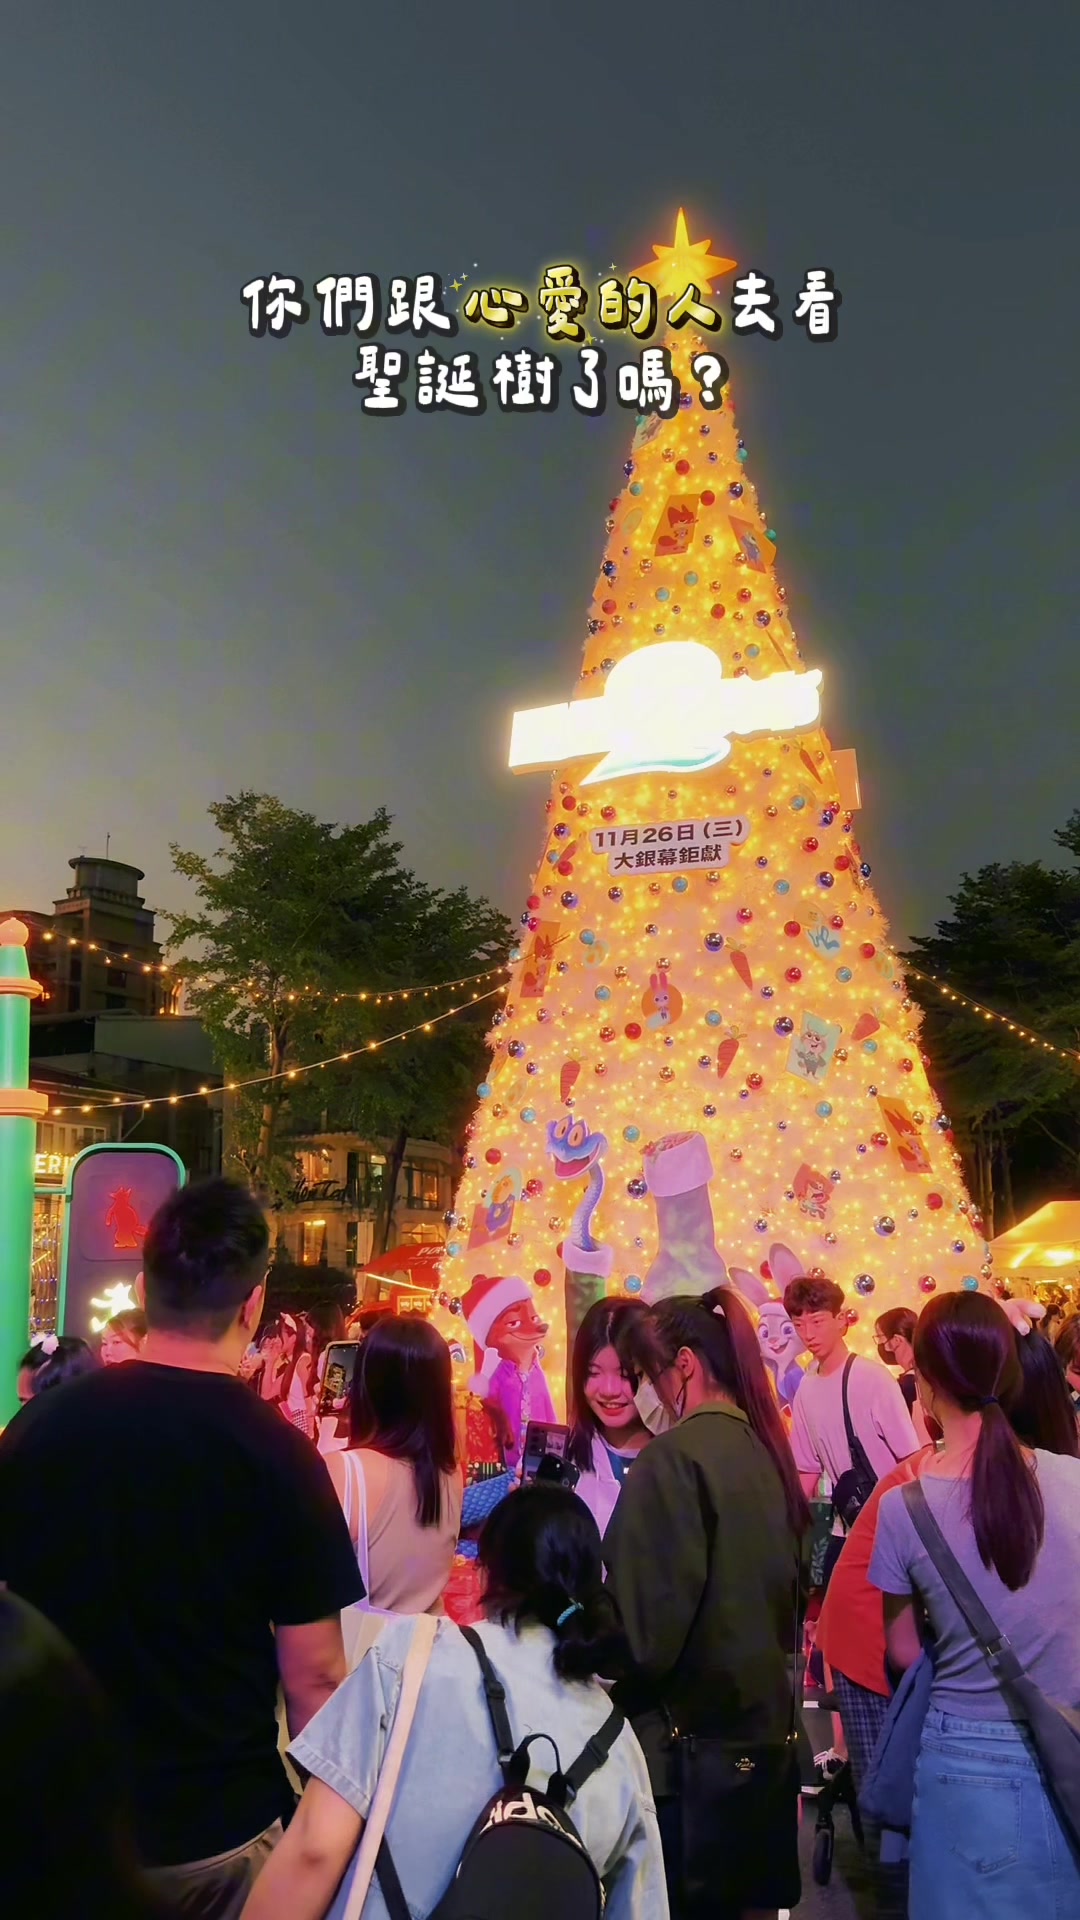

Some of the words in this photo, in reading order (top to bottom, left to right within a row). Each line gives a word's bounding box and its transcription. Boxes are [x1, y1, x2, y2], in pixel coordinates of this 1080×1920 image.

[614, 844, 722, 870] 大銀幕鉅獻
